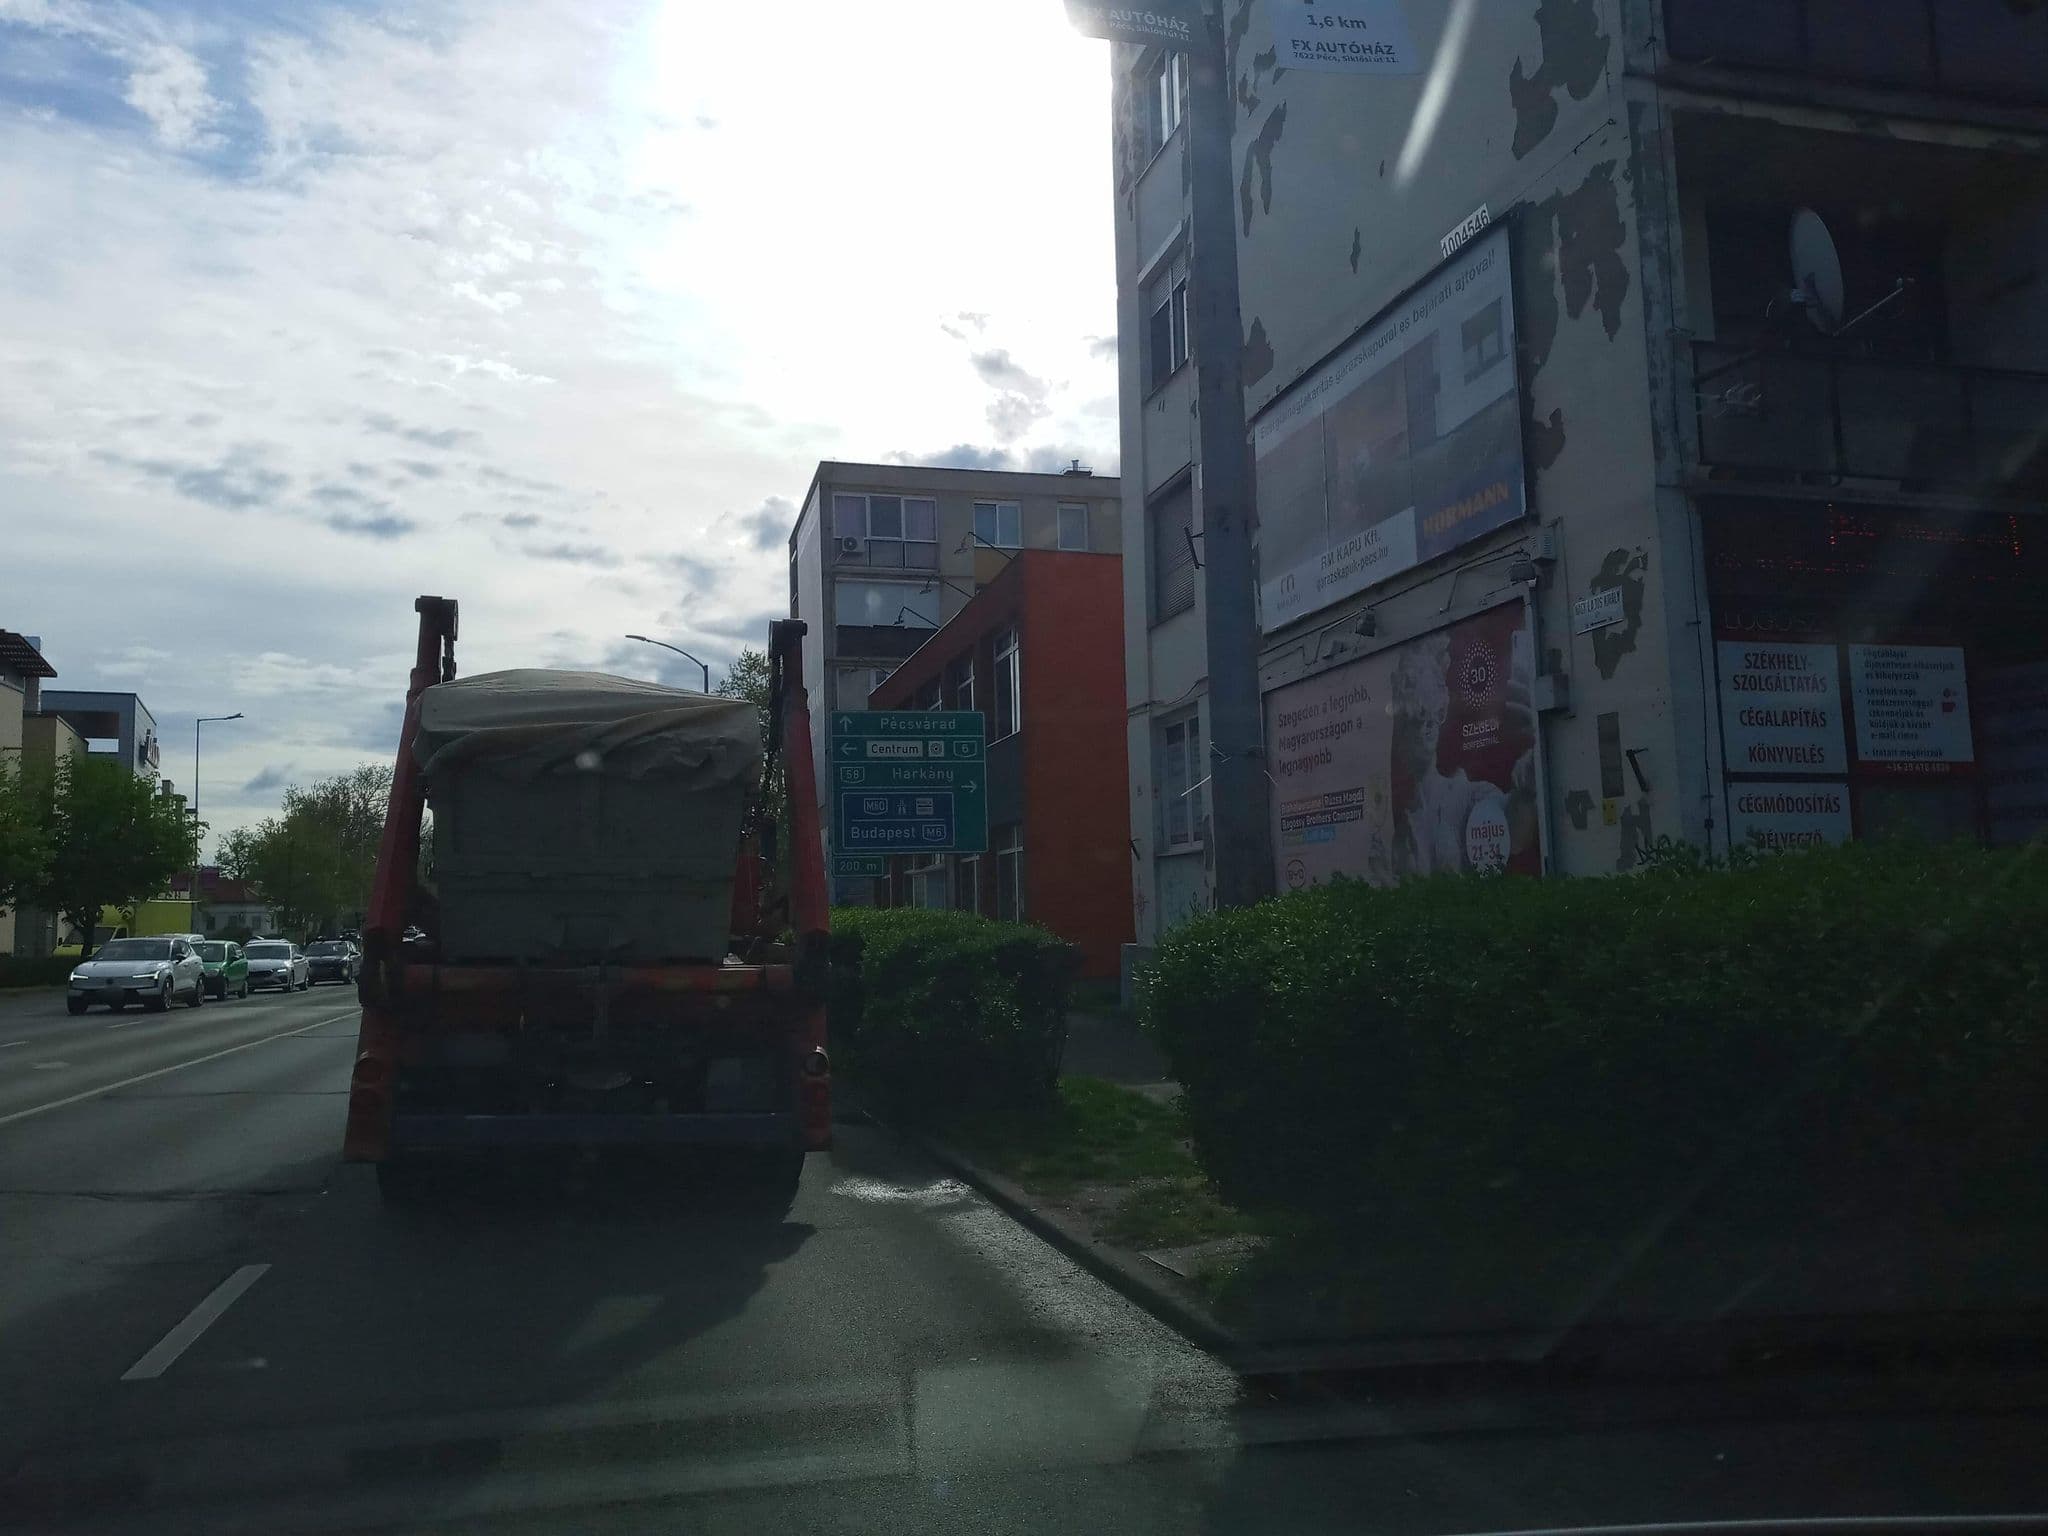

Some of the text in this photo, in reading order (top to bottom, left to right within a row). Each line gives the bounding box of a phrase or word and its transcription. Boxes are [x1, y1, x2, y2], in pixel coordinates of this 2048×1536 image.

[1307, 14, 1367, 30] 1,6 km
[1292, 39, 1396, 56] FX AUTÓHÁZ
[1441, 209, 1489, 259] 1004546
[1337, 540, 1362, 561] KAPU
[1744, 650, 1812, 670] SZÉKHELY-
[1471, 666, 1486, 684] 30
[1733, 673, 1827, 693] SZOLGÁLTATÁS
[1279, 703, 1319, 728] Szegeden
[1329, 685, 1371, 713] legjobb,
[1740, 706, 1826, 727] CÉGALAPÍTÁS
[880, 716, 956, 730] Pécsvárad
[1279, 719, 1353, 752] Magyarországon
[871, 744, 919, 754] Centrum
[1748, 743, 1825, 763] KÖNYVELÉS
[1279, 746, 1332, 777] legnagyobb
[846, 766, 954, 782] 58 Harkány
[1738, 793, 1840, 813] CÉGMÓDOSÍTÁS
[851, 826, 942, 841] Budapest M6
[1472, 820, 1504, 841] május
[840, 862, 860, 872] 200
